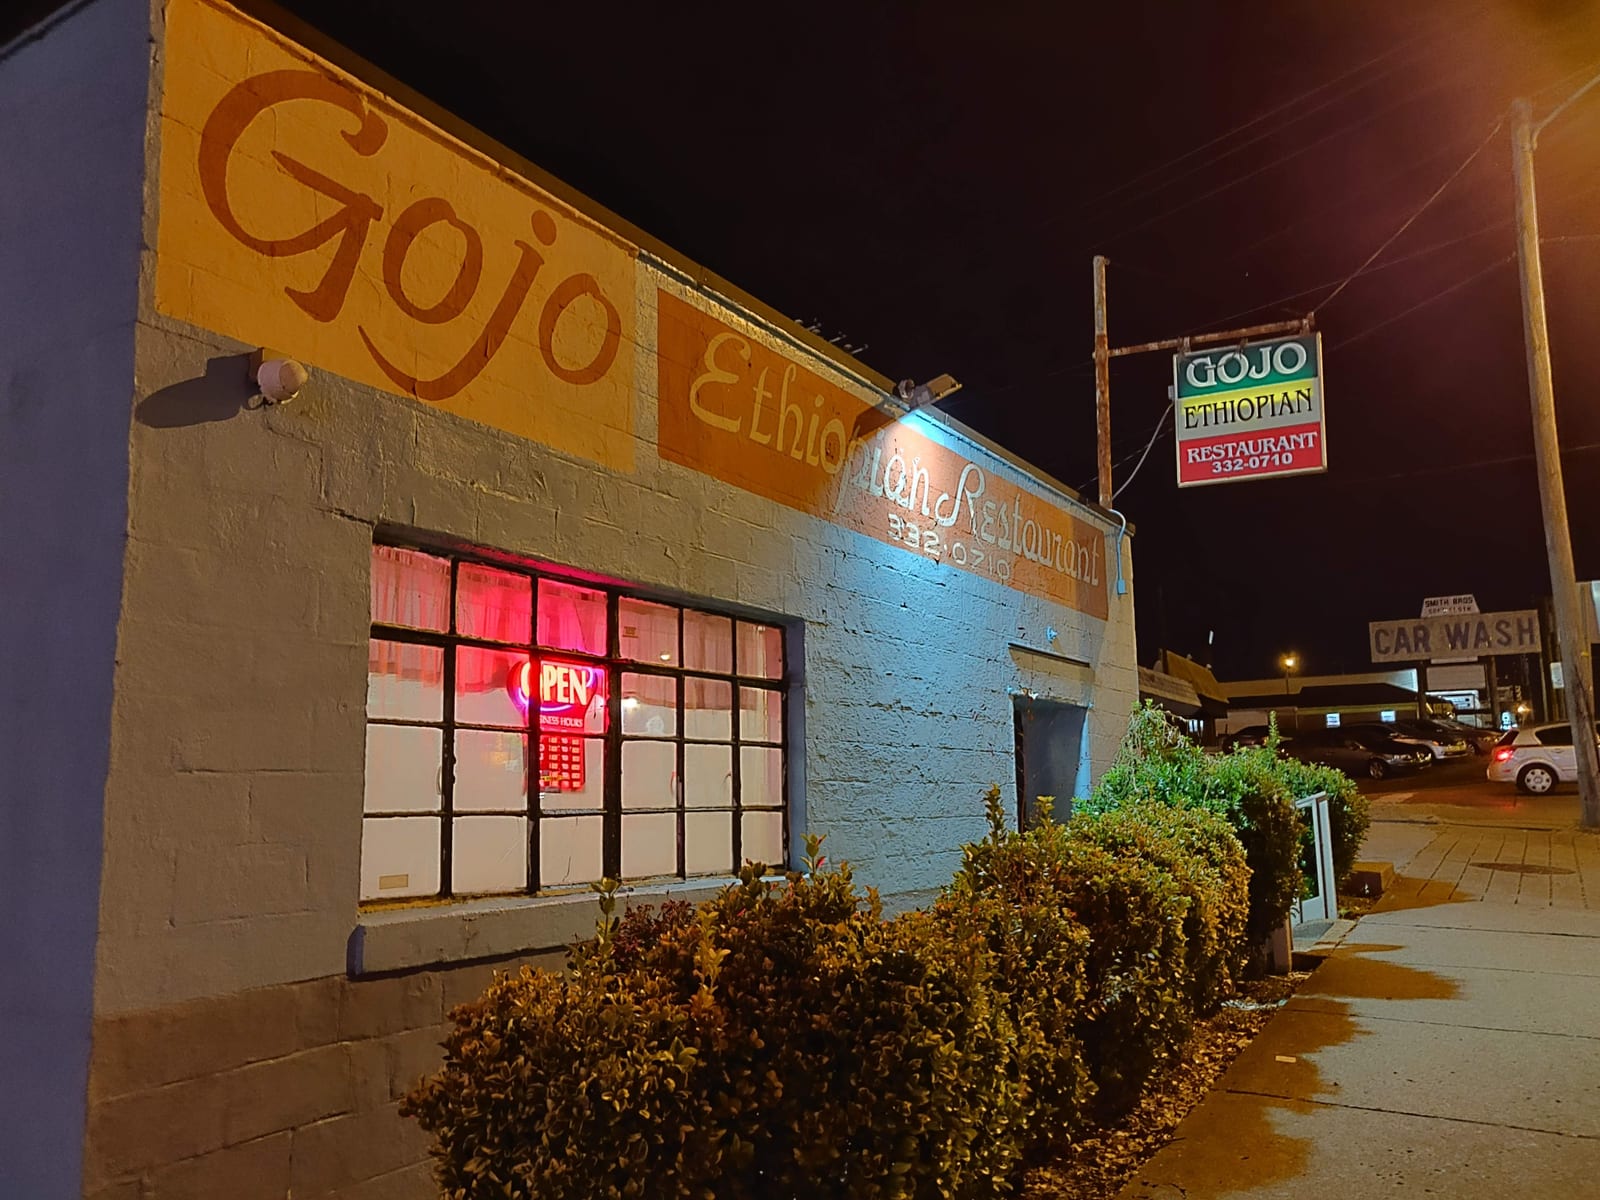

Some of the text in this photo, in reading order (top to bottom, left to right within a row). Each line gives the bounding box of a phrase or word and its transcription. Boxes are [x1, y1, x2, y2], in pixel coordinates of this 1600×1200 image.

[199, 69, 621, 400] Gojo
[1186, 341, 1307, 388] GOJO
[1184, 388, 1313, 429] ETHIOPIAN
[689, 332, 1099, 586] Ethiopian Restaurant
[1187, 431, 1318, 464] RESTAURANT
[1212, 452, 1293, 474] 332-0710
[1375, 617, 1536, 655] CAR WASH
[520, 661, 588, 706] OPEN
